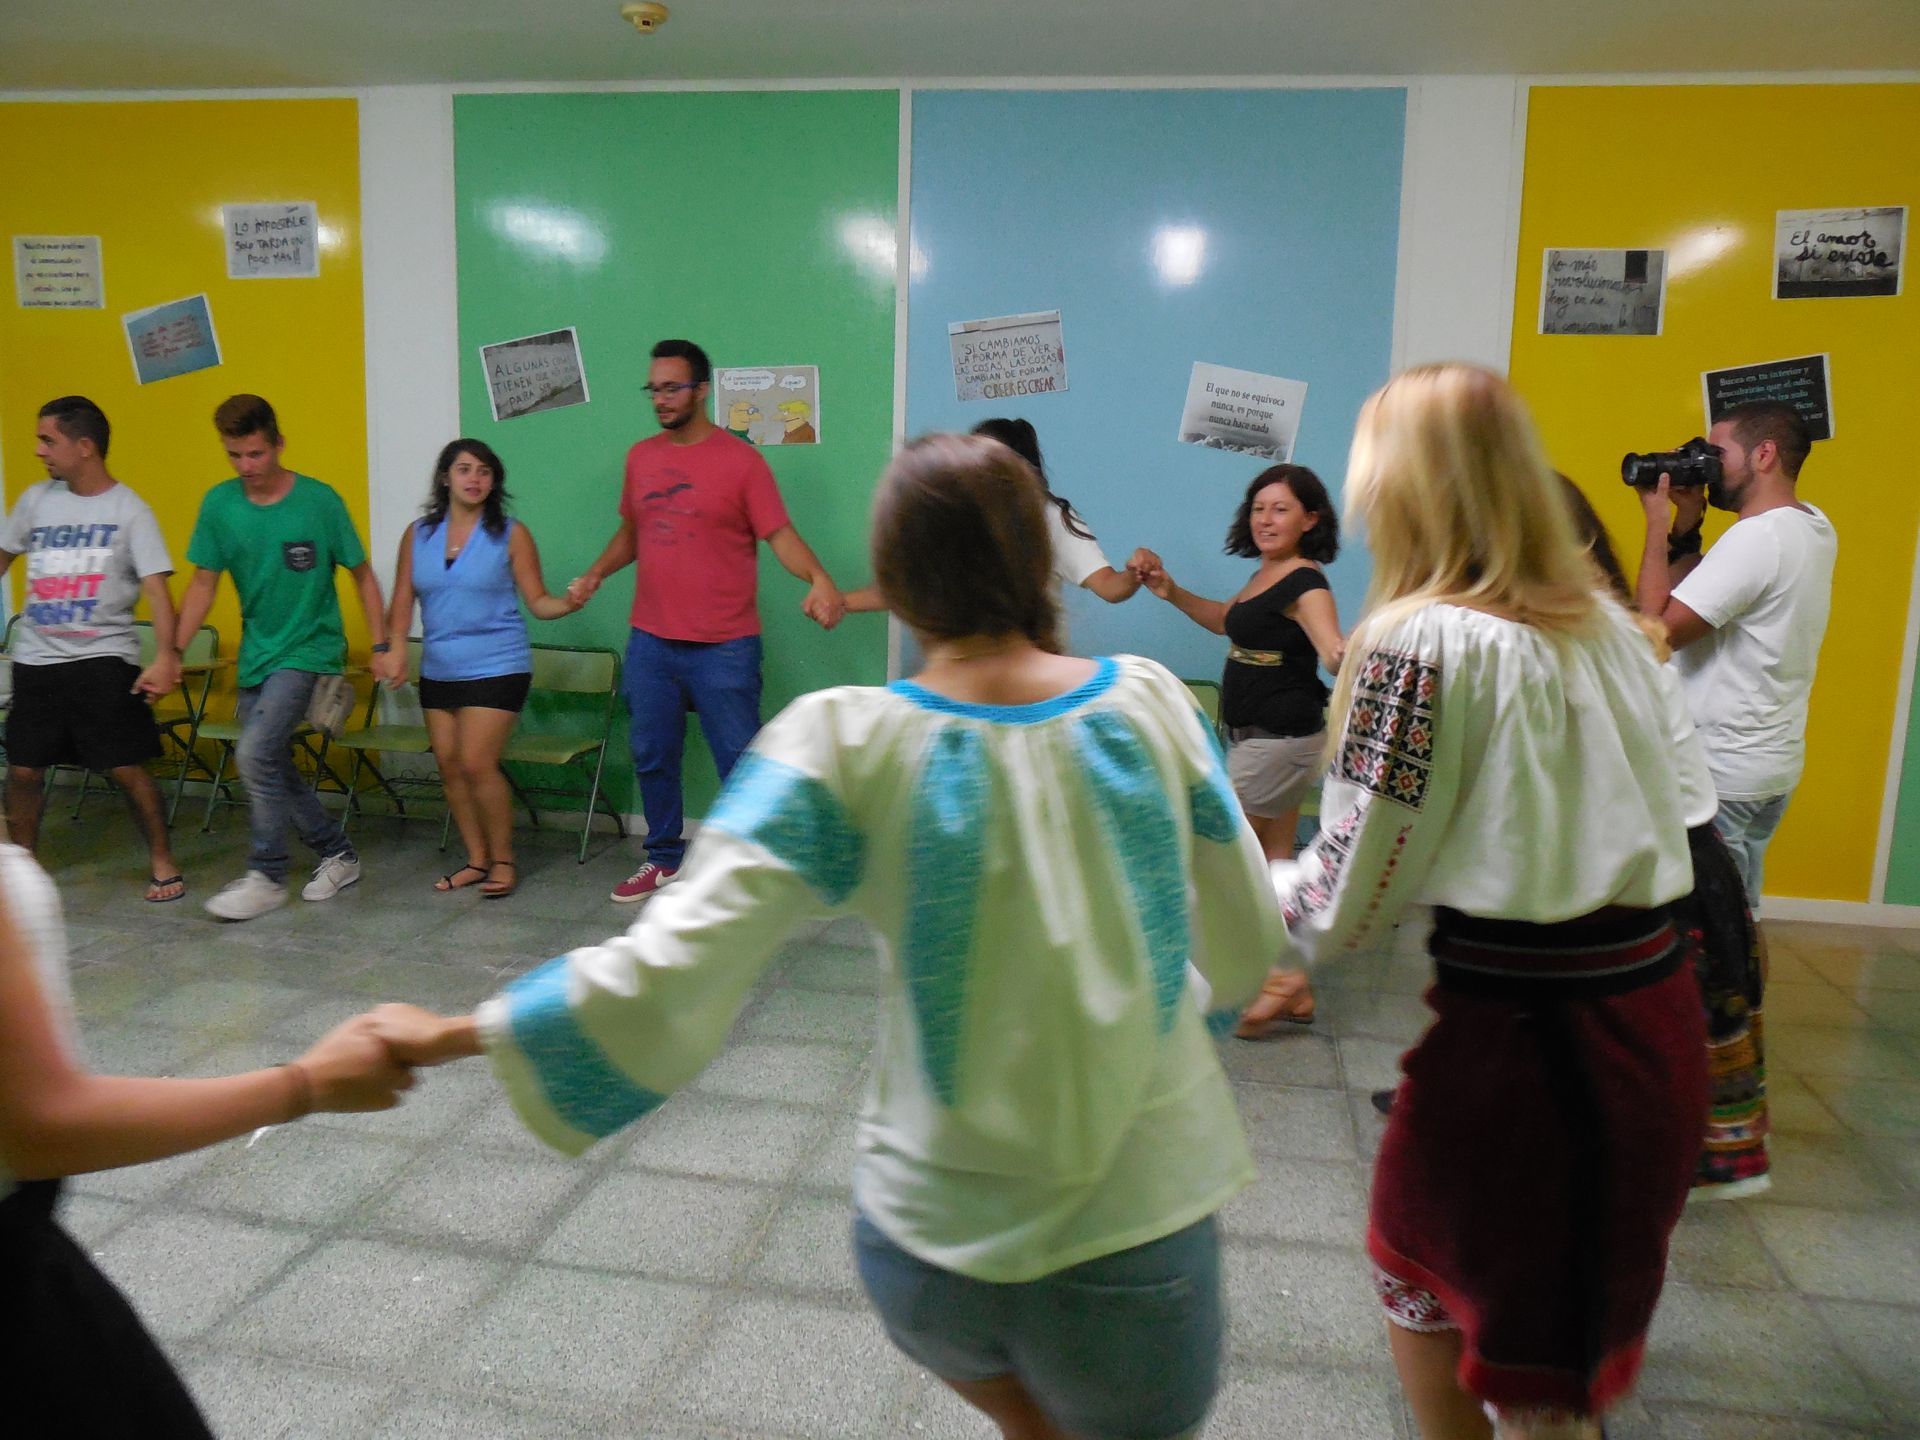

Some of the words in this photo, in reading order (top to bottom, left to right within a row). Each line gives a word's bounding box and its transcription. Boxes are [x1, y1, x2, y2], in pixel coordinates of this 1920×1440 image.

[234, 222, 249, 236] LO
[257, 238, 289, 250] TARDA
[1790, 230, 1811, 246] El
[1817, 230, 1876, 249] amor
[978, 334, 1040, 352] CAMBIAMOS
[958, 355, 970, 365] LA
[973, 350, 1008, 362] FORMA
[1013, 346, 1027, 358] DE
[1031, 343, 1051, 355] VER
[1010, 357, 1026, 368] LAS
[1028, 352, 1057, 364] COSAS
[495, 359, 550, 378] ALGUNAS
[966, 372, 1001, 384] CAMBIAN
[1005, 369, 1016, 379] DE
[493, 376, 533, 395] TIENEN
[983, 382, 1016, 399] CREER
[1017, 379, 1028, 395] ES
[1029, 376, 1057, 393] CREAR
[1206, 382, 1214, 392] El
[1215, 387, 1229, 397] que
[1231, 389, 1240, 398] no
[1242, 391, 1250, 400] se
[1251, 393, 1285, 406] equivoca
[508, 390, 534, 409] PARA
[1211, 400, 1235, 413] nunca,
[1237, 406, 1245, 414] es
[1246, 408, 1274, 420] porque
[1208, 415, 1232, 426] nunca
[1232, 417, 1250, 429] hace
[1251, 423, 1270, 434] nada
